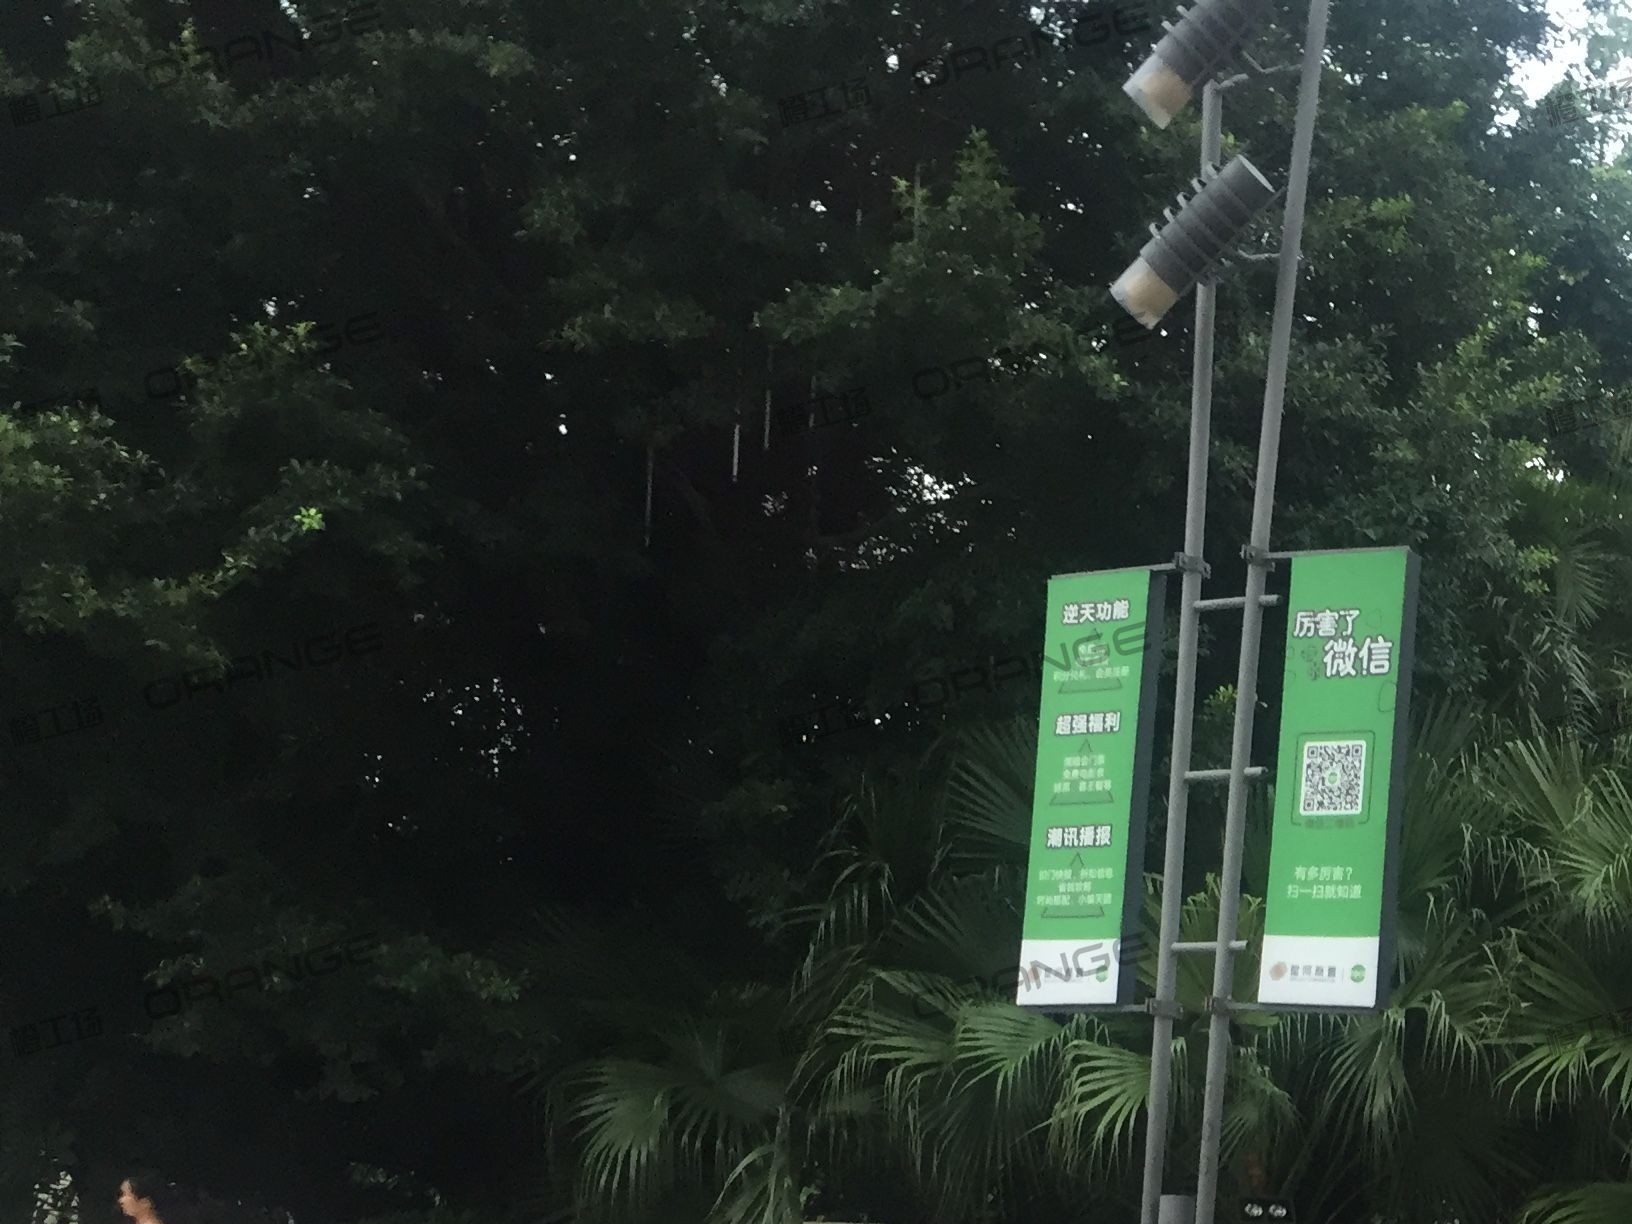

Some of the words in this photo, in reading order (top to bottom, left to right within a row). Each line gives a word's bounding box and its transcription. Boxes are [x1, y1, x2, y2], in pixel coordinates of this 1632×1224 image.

[1062, 600, 1130, 624] 逆天功能
[1293, 609, 1361, 638] 厉害了
[1323, 636, 1394, 678] 微信
[1055, 711, 1121, 735] 超强福利
[1046, 825, 1112, 848] 潮讯播报
[1287, 884, 1363, 900] 扫一扫就知道
